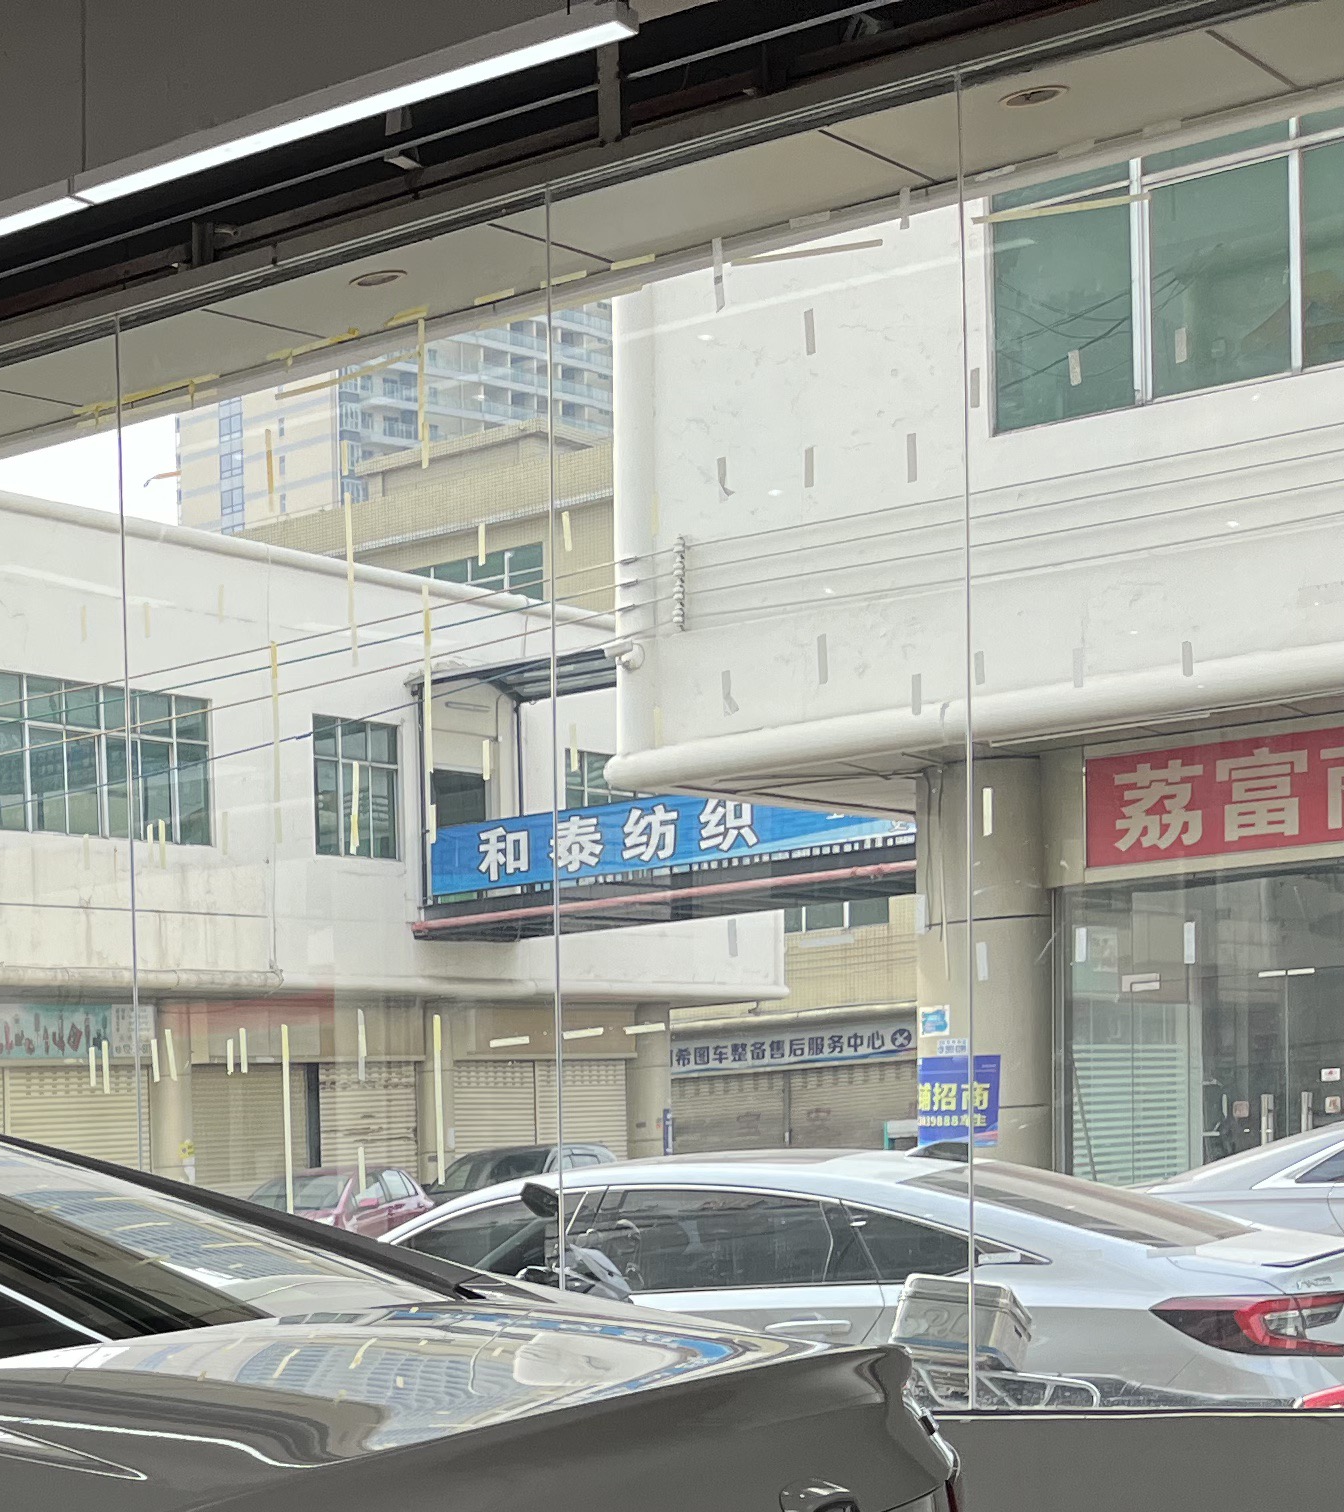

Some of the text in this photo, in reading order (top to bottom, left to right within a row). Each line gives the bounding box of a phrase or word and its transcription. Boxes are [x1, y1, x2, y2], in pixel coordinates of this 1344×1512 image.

[478, 798, 759, 882] 和泰纺织
[1114, 747, 1344, 852] 荔富
[670, 1030, 886, 1068] 希图车整备售后服务中心
